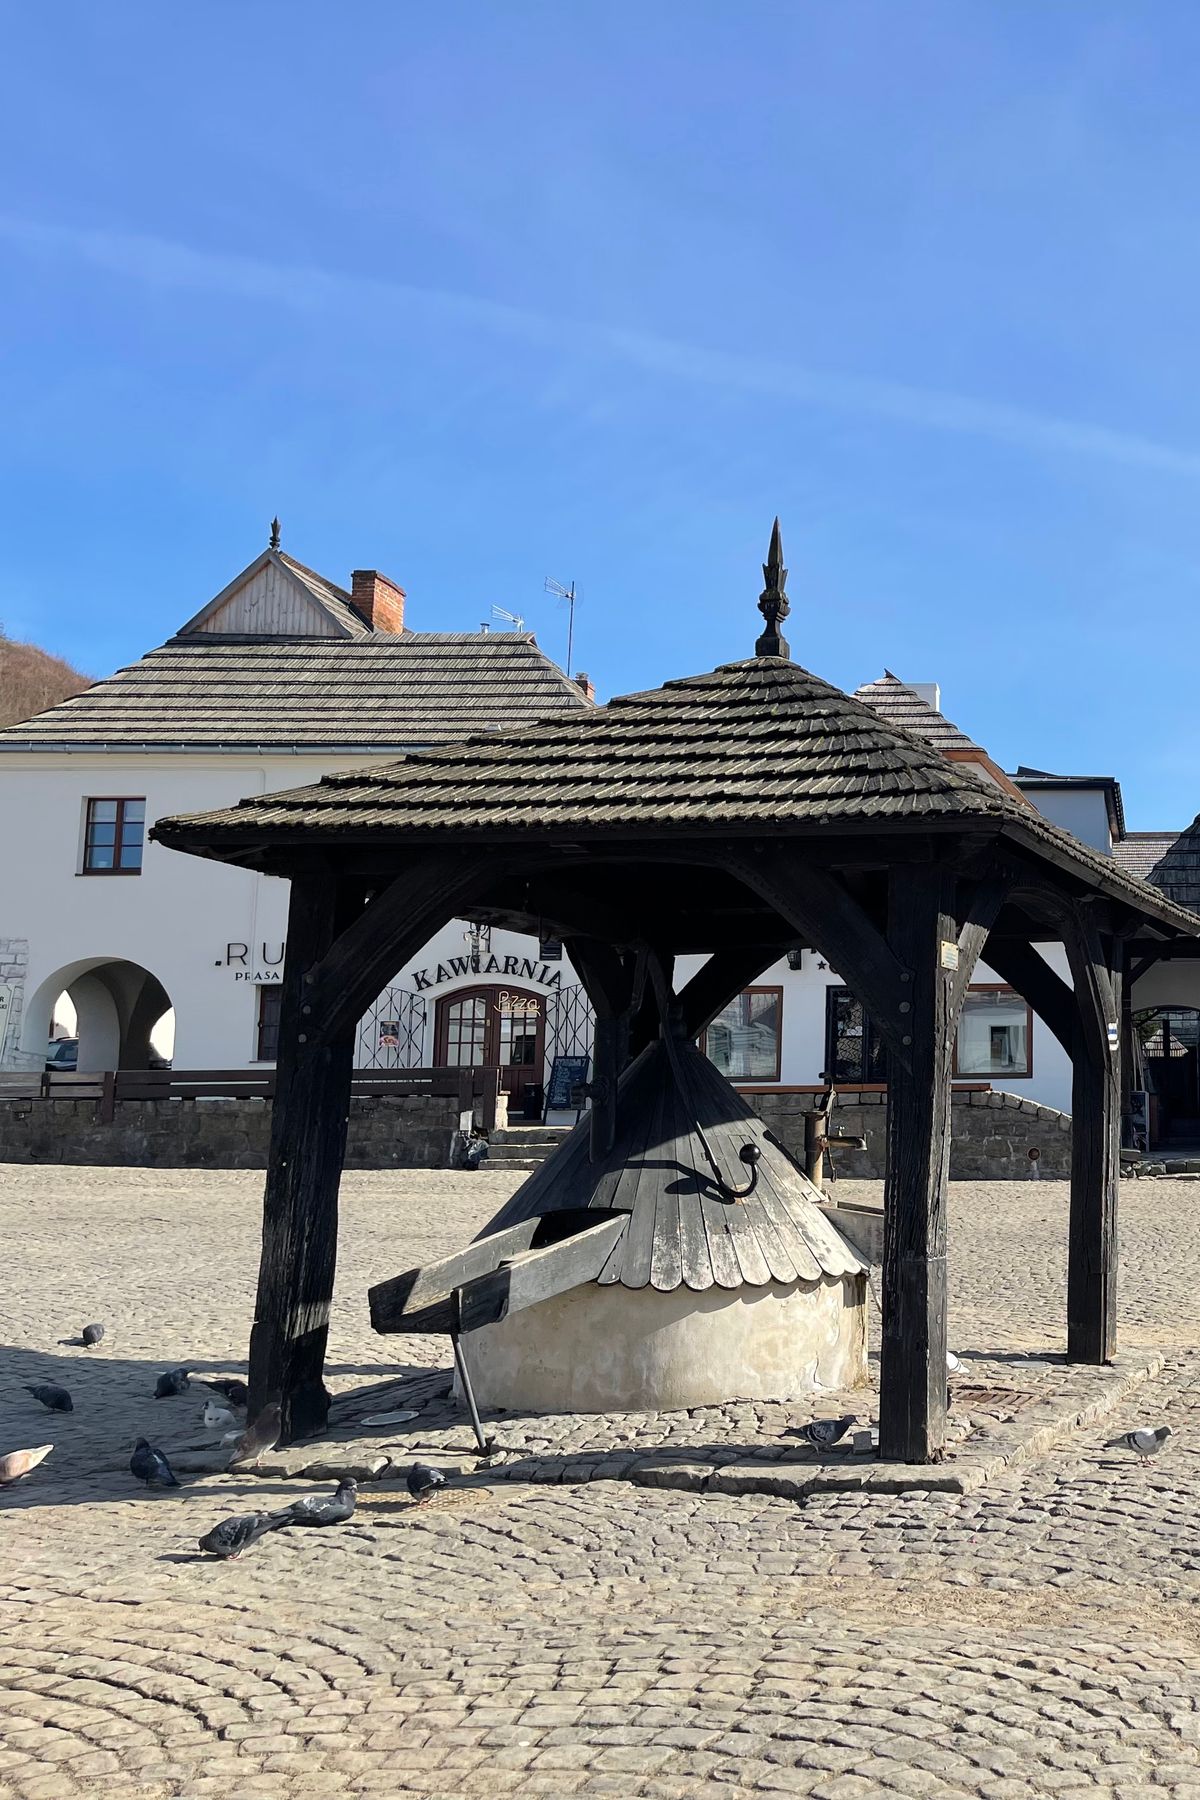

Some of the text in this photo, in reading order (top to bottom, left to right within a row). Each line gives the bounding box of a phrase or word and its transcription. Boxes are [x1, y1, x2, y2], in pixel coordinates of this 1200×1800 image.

[235, 971, 280, 981] PRASA
[411, 954, 562, 992] KAWIARNIA
[498, 991, 541, 1011] Pizza
